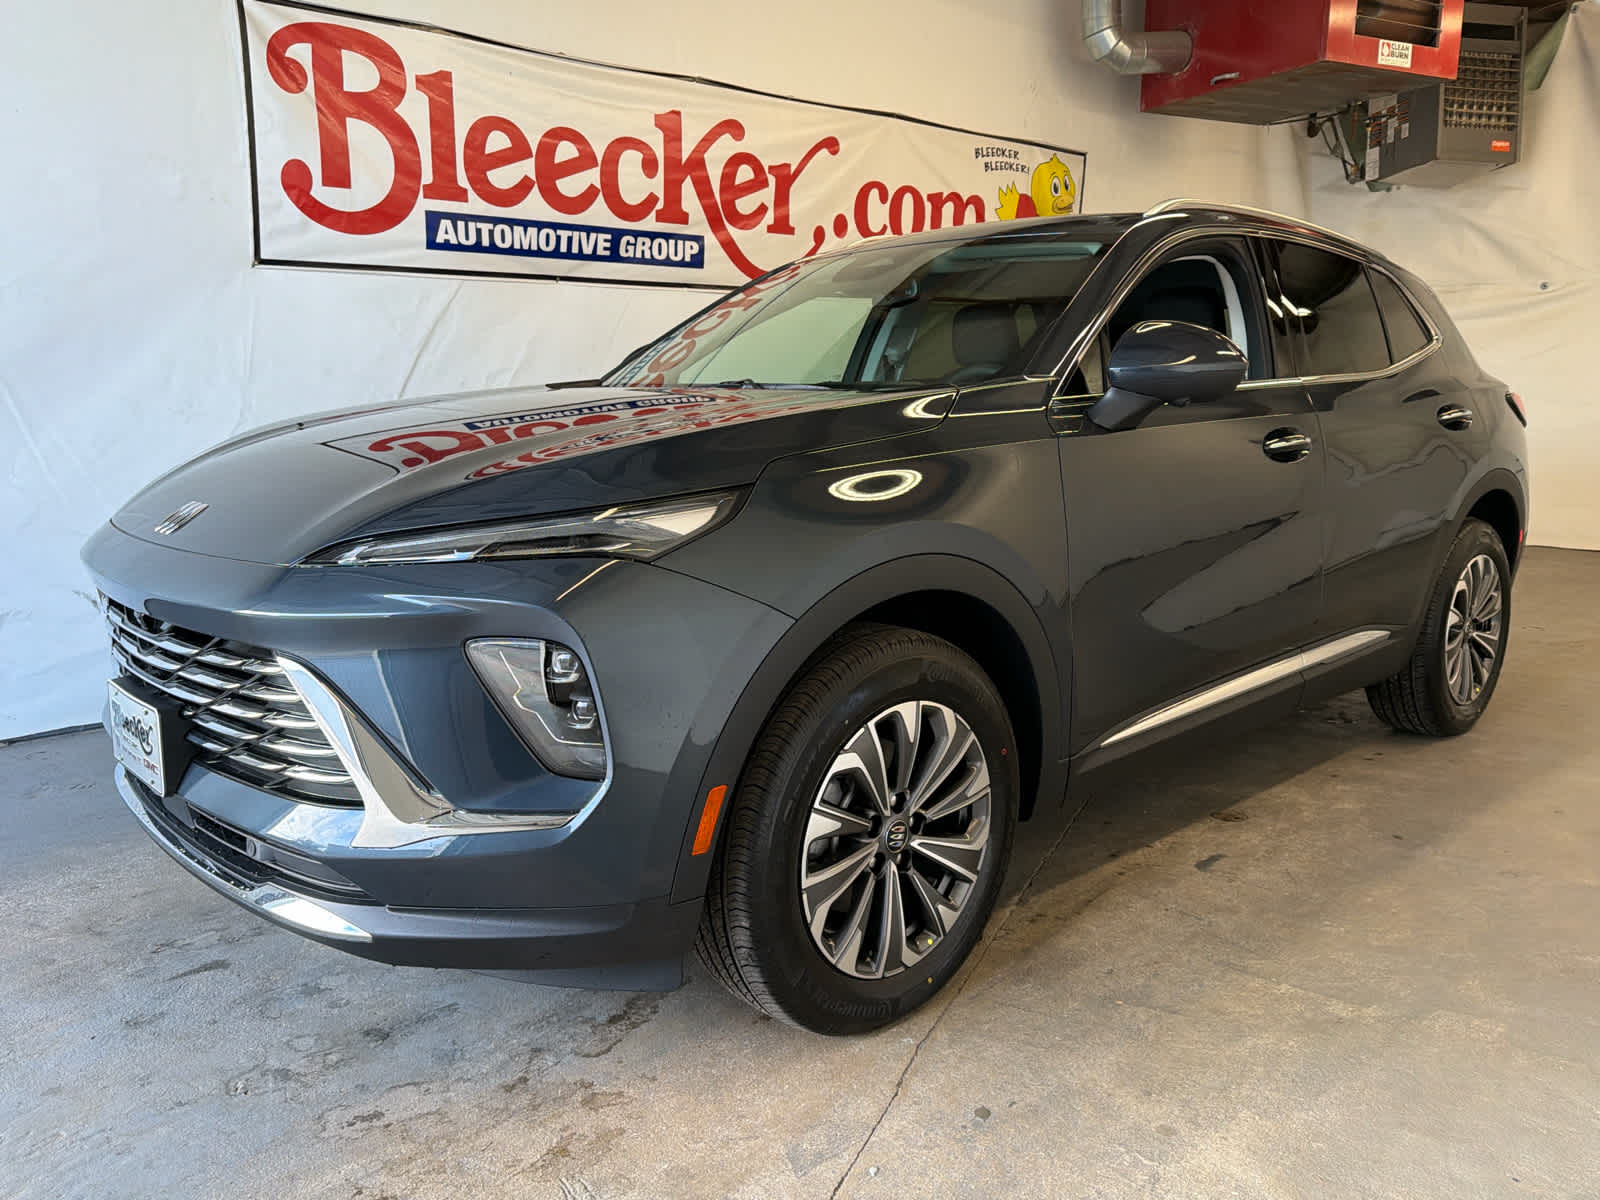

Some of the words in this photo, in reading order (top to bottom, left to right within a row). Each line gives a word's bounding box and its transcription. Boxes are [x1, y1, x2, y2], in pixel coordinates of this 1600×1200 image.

[1391, 43, 1409, 51] CLEAN
[1391, 51, 1409, 59] BURN
[974, 147, 1019, 160] BLEECKER
[984, 161, 1030, 175] BLEECKER!
[435, 219, 612, 256] AUTOMOTIVE
[619, 236, 700, 262] GROUP
